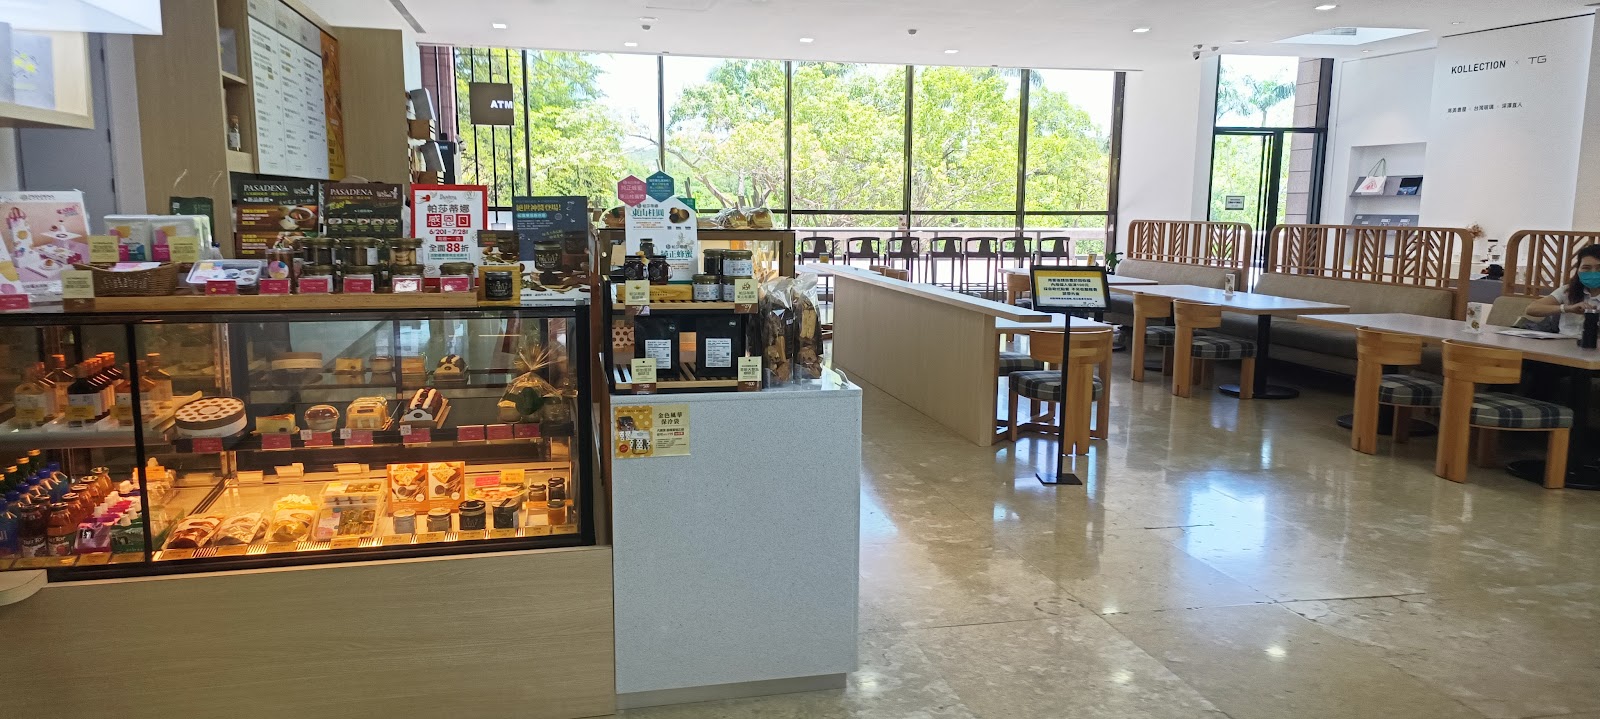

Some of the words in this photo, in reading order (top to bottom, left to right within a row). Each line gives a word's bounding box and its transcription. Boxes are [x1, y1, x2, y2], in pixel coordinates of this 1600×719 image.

[1451, 60, 1506, 74] KOLLECTION
[1528, 55, 1547, 64] TG
[490, 99, 513, 109] ATM
[243, 184, 289, 192] PASADENA
[330, 188, 373, 196] PASADENA
[427, 204, 470, 214] 帕莎蒂娜
[428, 243, 469, 253] 全面88折
